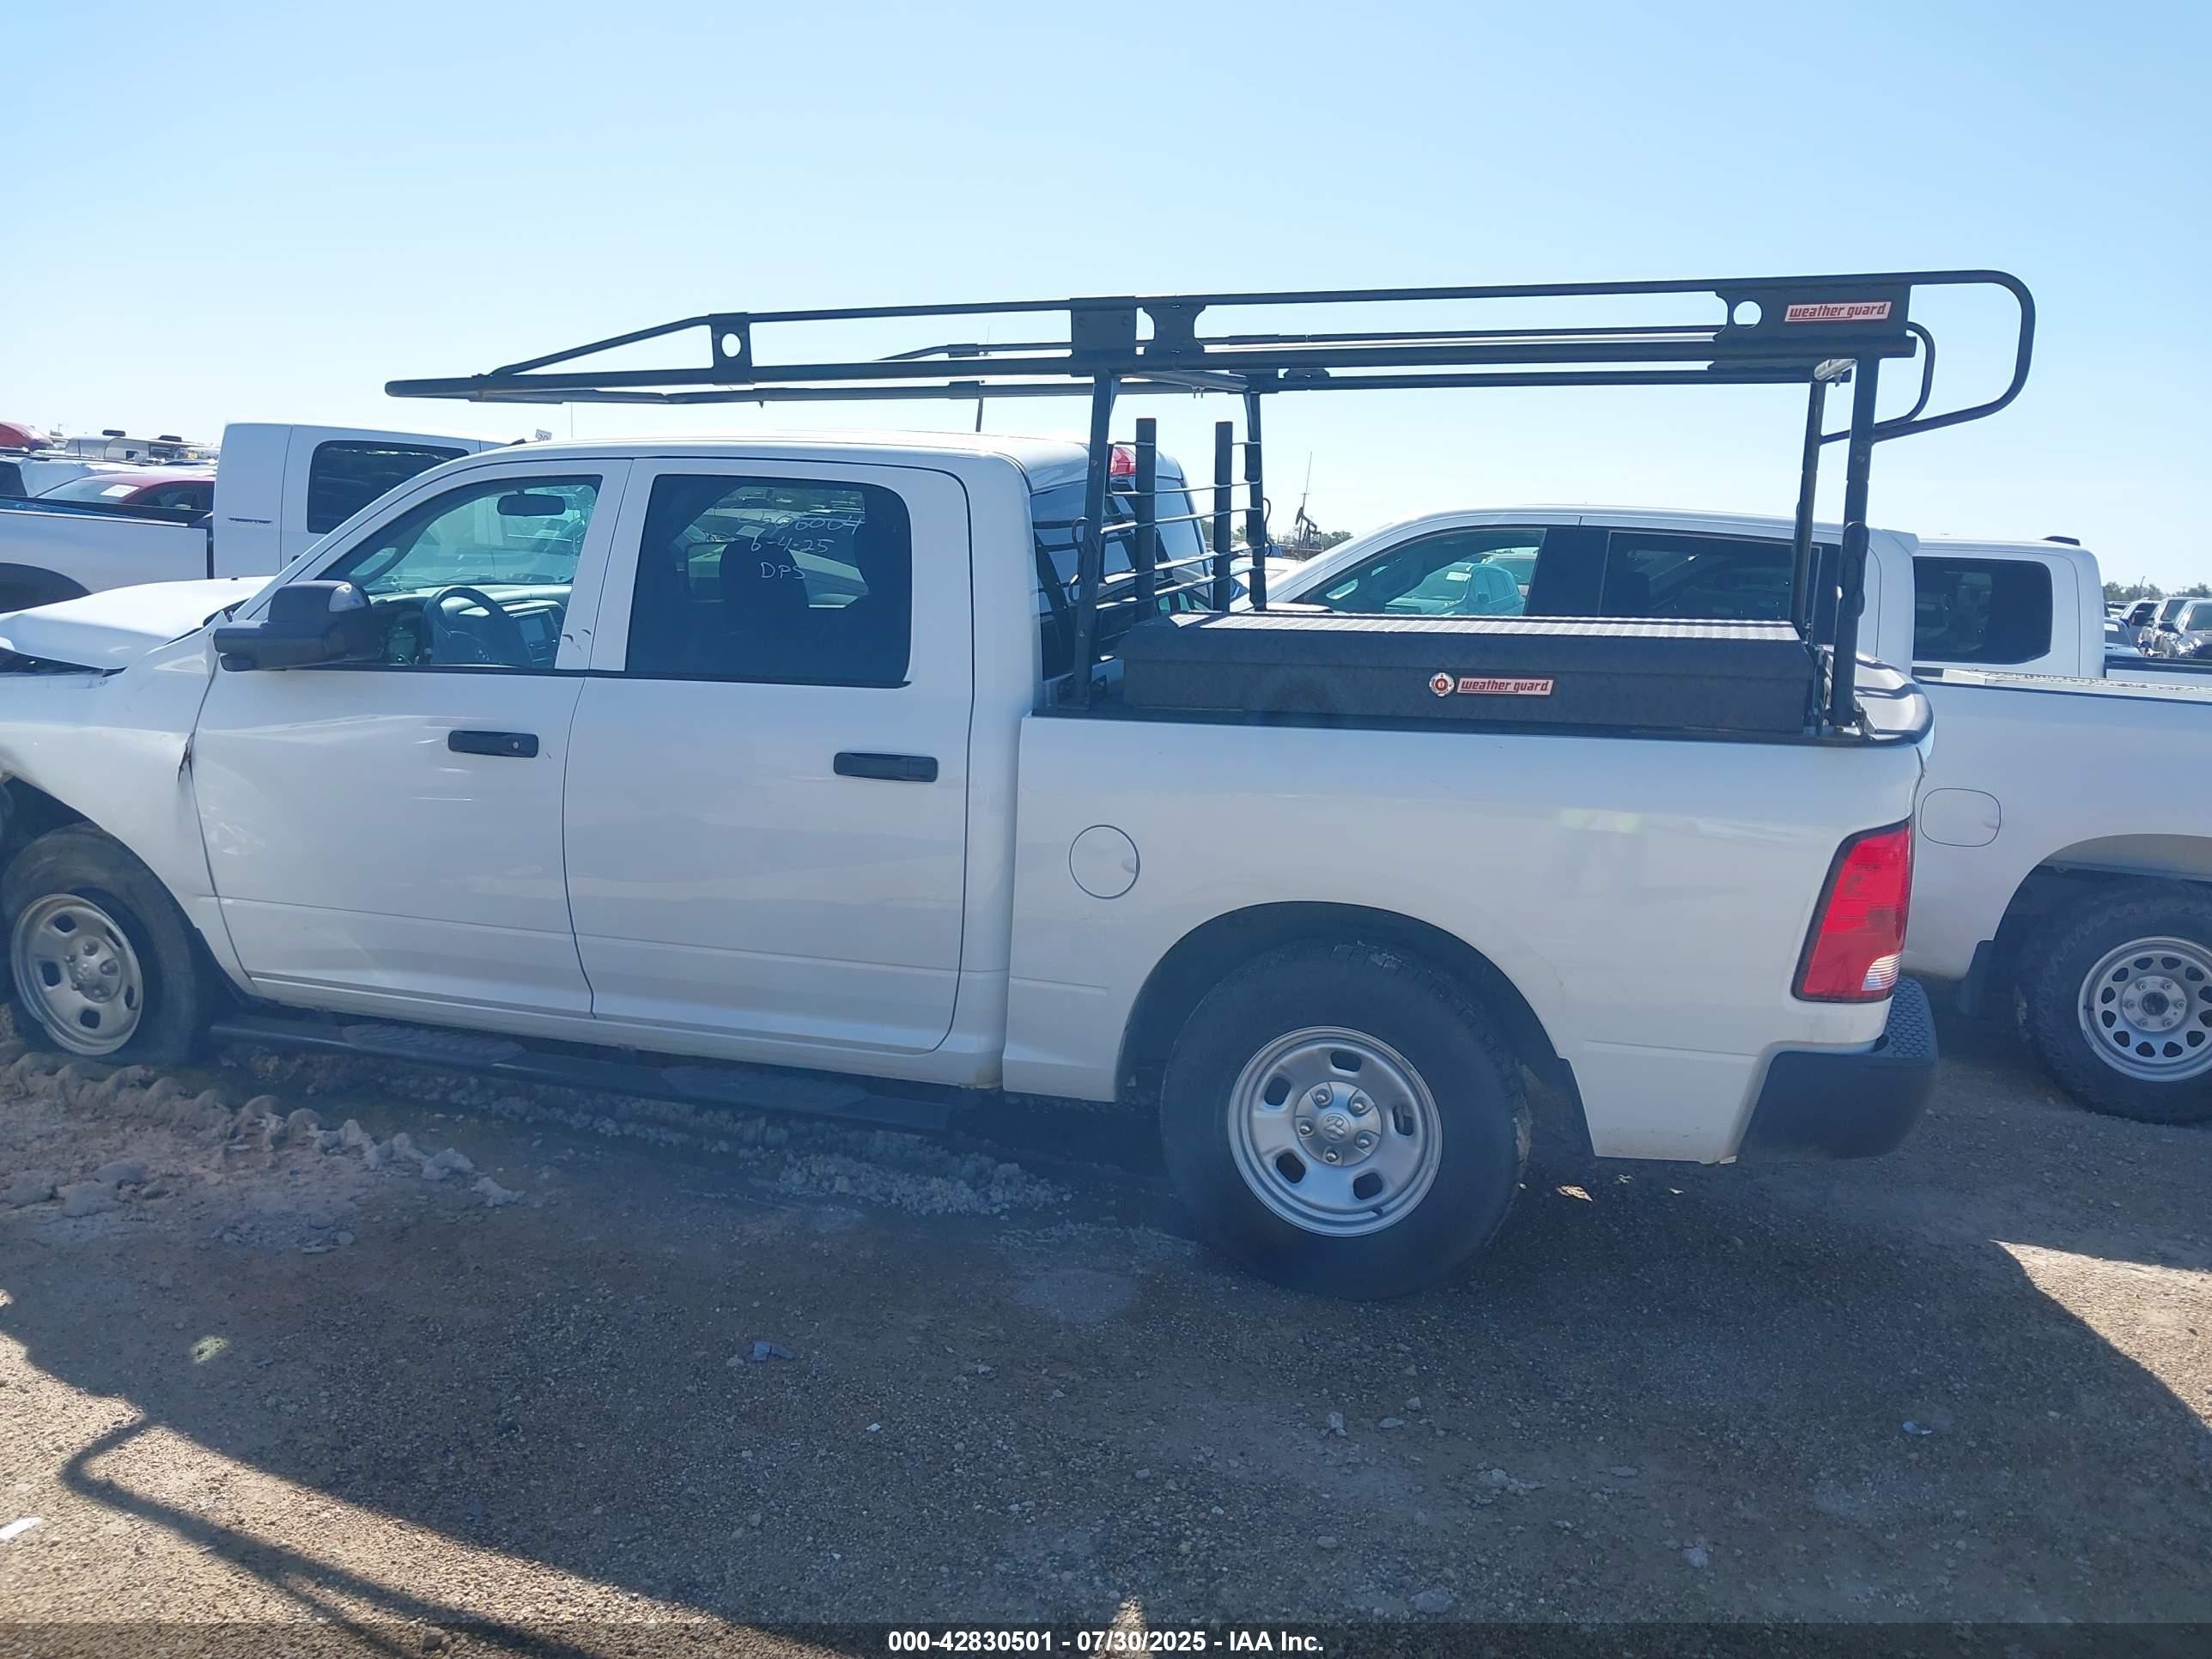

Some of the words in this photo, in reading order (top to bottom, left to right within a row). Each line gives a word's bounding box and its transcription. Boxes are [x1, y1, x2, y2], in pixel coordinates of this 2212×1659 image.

[1790, 305, 1845, 318] weather
[1846, 303, 1887, 318] guard
[750, 535, 836, 553] 6-4-25
[760, 562, 805, 580] DPS
[1461, 679, 1511, 691] weather
[1513, 680, 1549, 692] guard
